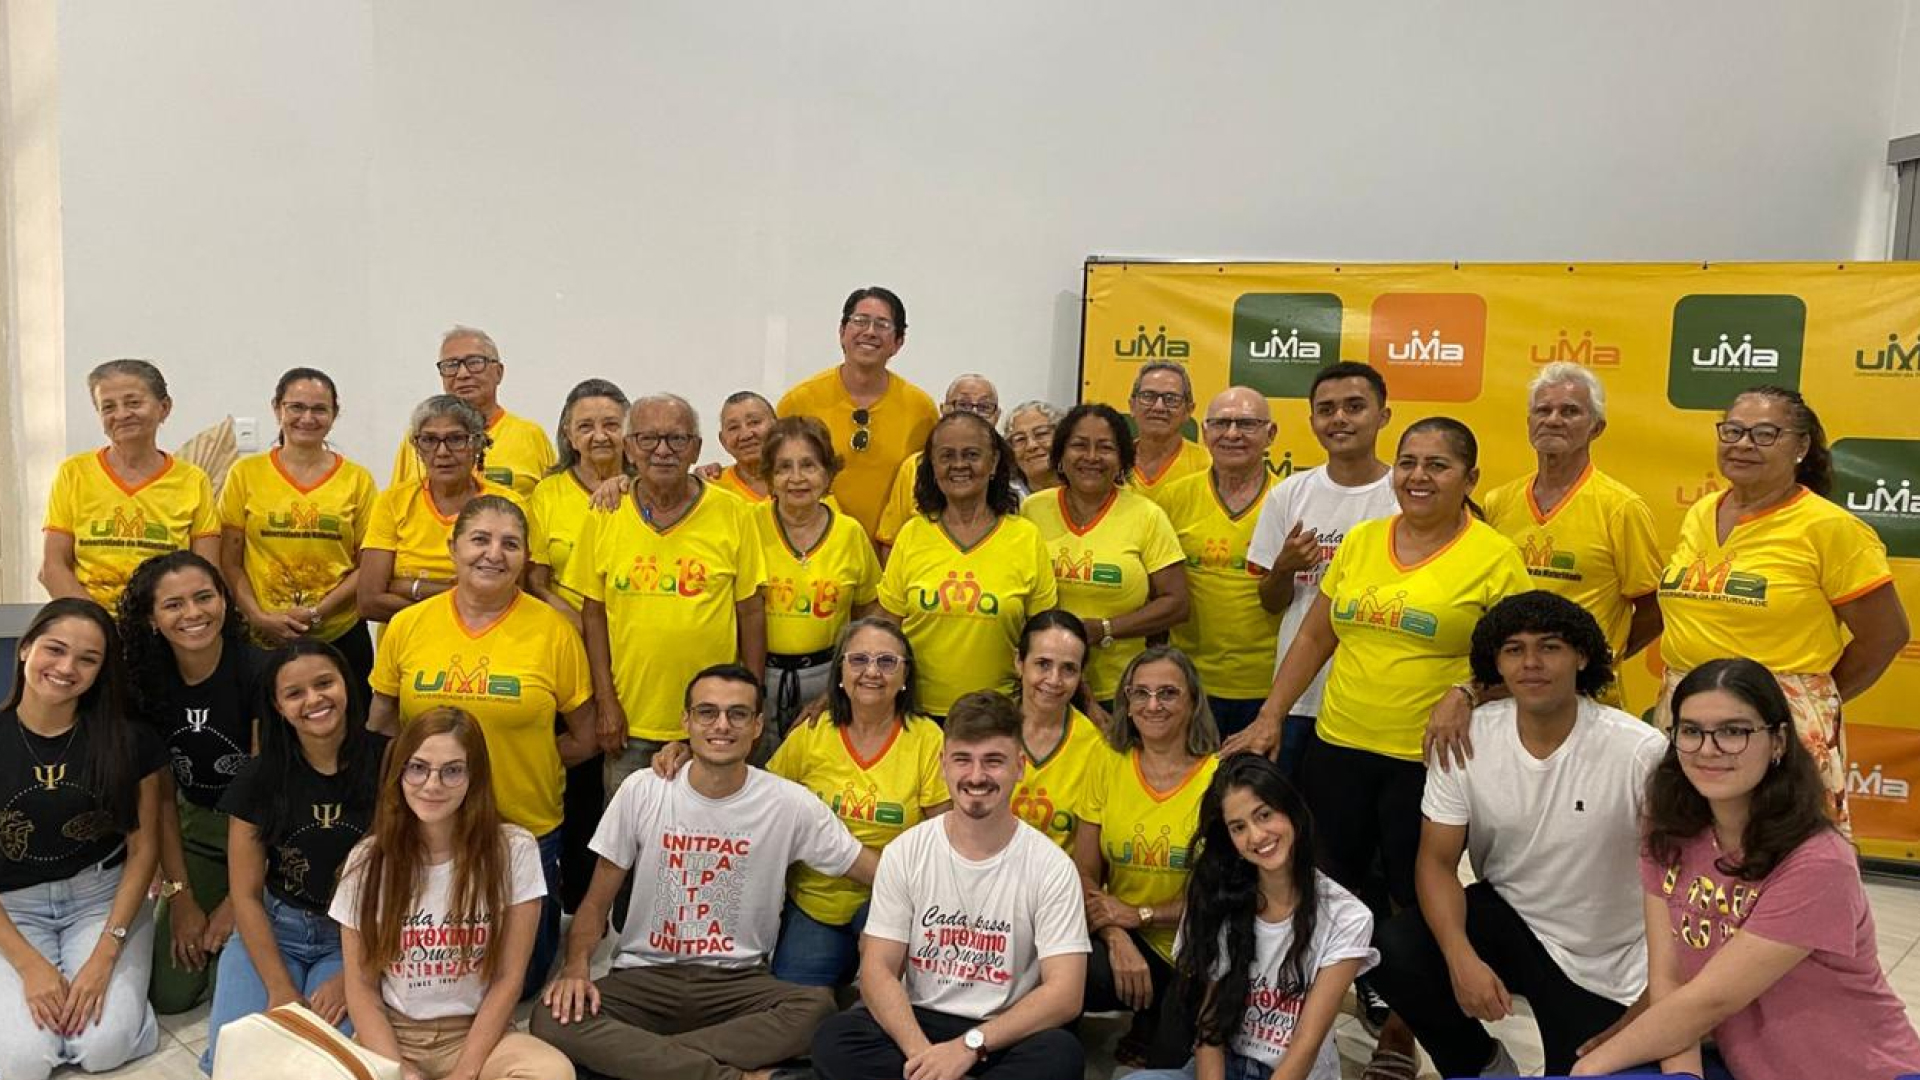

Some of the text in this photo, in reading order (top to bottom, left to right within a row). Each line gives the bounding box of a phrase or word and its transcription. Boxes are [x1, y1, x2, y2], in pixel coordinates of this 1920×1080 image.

[1856, 333, 1920, 370] uM
[1847, 762, 1909, 797] Ma
[650, 932, 734, 955] UNITPAC
